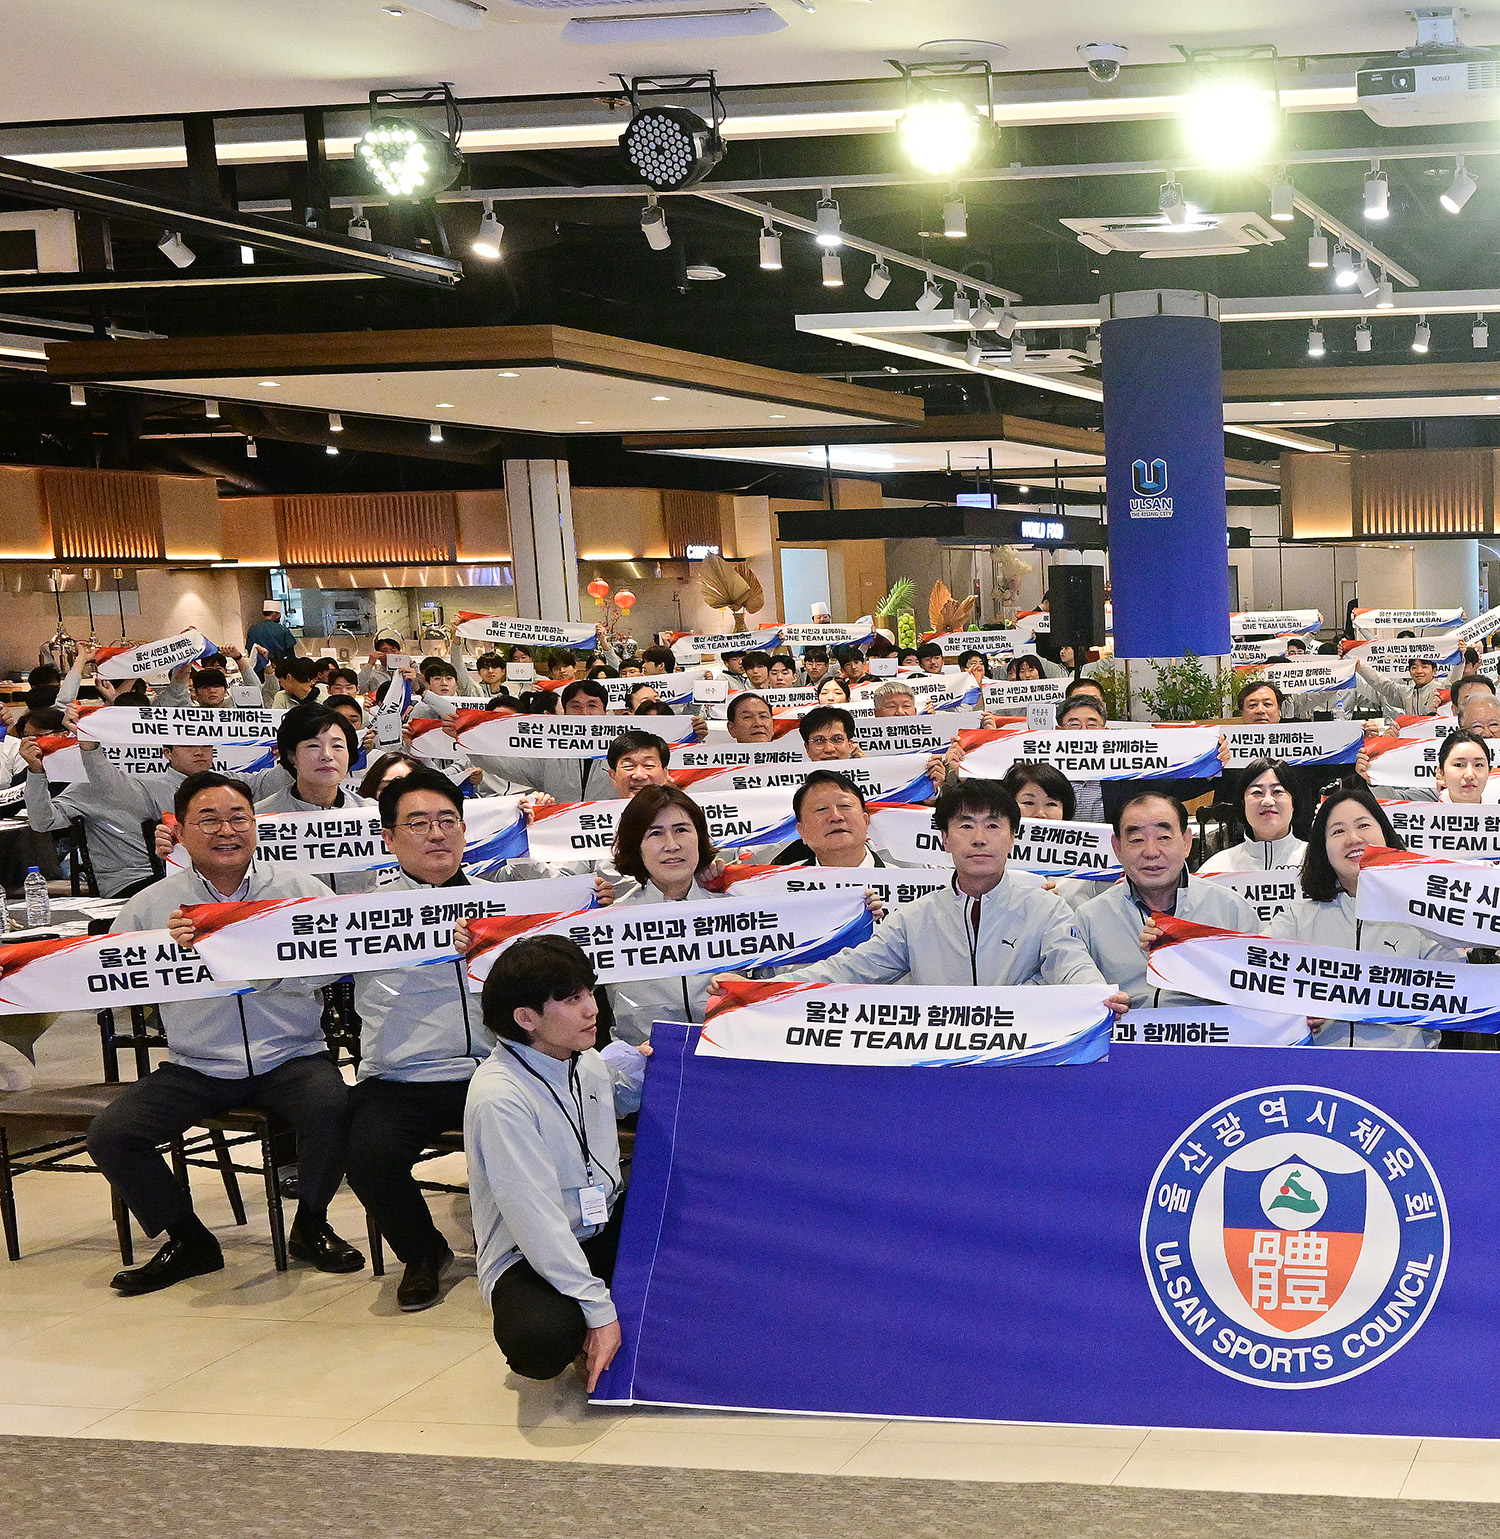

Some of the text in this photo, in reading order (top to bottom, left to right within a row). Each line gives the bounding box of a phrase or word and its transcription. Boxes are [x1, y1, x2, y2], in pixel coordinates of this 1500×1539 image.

[1130, 498, 1173, 511] ULSAN
[486, 629, 569, 643] ONE TEAM ULSAN
[492, 620, 564, 634] 울산 시민과 함께하는
[985, 692, 1064, 705] ONE TEAM ULSAN
[990, 684, 1059, 696] 울산 시민과 함께하는
[139, 708, 272, 723] 울산 시민과 함께하는
[132, 723, 169, 734] ONE
[173, 724, 222, 736] TEAM
[1023, 740, 1158, 754] 울산 시민과 함께하는
[1054, 757, 1167, 770] TEAM ULSAN
[1427, 875, 1471, 903] 울산
[292, 900, 508, 935] 울산 시민과 함께하는
[1409, 900, 1465, 926] ONE
[568, 911, 778, 948] 울산 시민과 함께하는
[99, 946, 146, 968] 울산
[277, 932, 425, 961] ONE TEAM
[622, 932, 796, 966] TEAM ULSAN
[1247, 946, 1455, 989] 울산 시민과 함께하는
[88, 971, 149, 992] ONE
[1230, 969, 1471, 1014] ONE TEAM ULSAN
[806, 1002, 1014, 1026] 울산 시민과 함께하는
[786, 1027, 1027, 1050] ONE TEAM ULSAN
[1159, 1097, 1436, 1222] 울산광역시체육회
[1248, 1230, 1329, 1312] 體
[1156, 1241, 1434, 1373] ULSAN SPORTS COUNCIL
